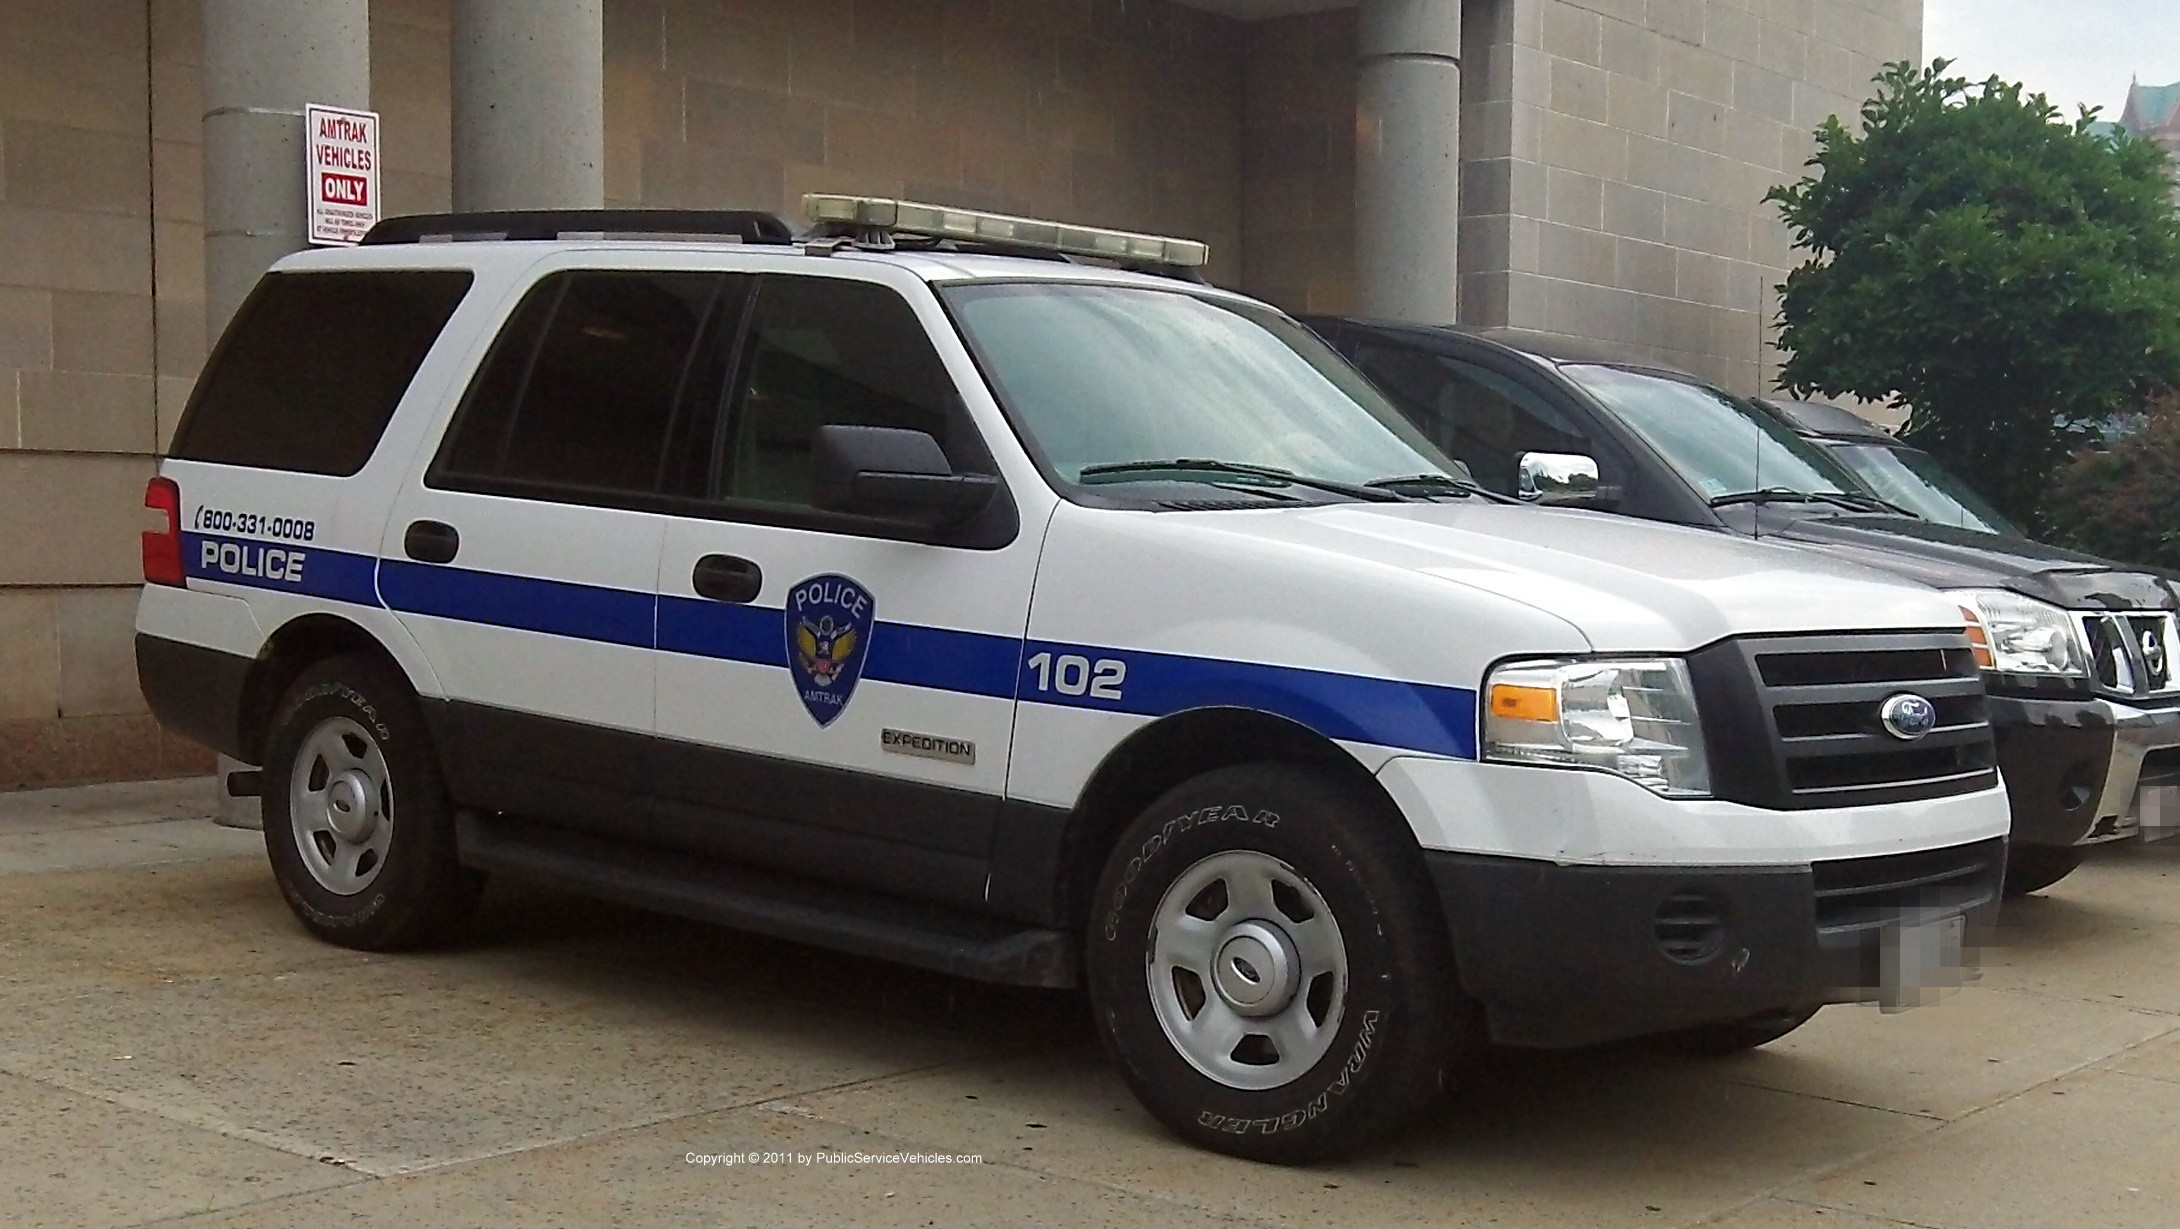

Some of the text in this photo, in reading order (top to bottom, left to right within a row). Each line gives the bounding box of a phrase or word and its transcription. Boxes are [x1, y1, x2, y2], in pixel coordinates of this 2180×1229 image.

[319, 117, 367, 143] AMTRAK
[316, 144, 371, 171] VEHICLES
[325, 177, 364, 201] ONLY
[201, 540, 306, 582] POLICE
[795, 582, 867, 619] POLICE
[1028, 652, 1126, 700] 102
[804, 690, 843, 706] AMTRAK
[881, 730, 971, 756] EXPEDITION
[1197, 1009, 1380, 1135] WRANGLER
